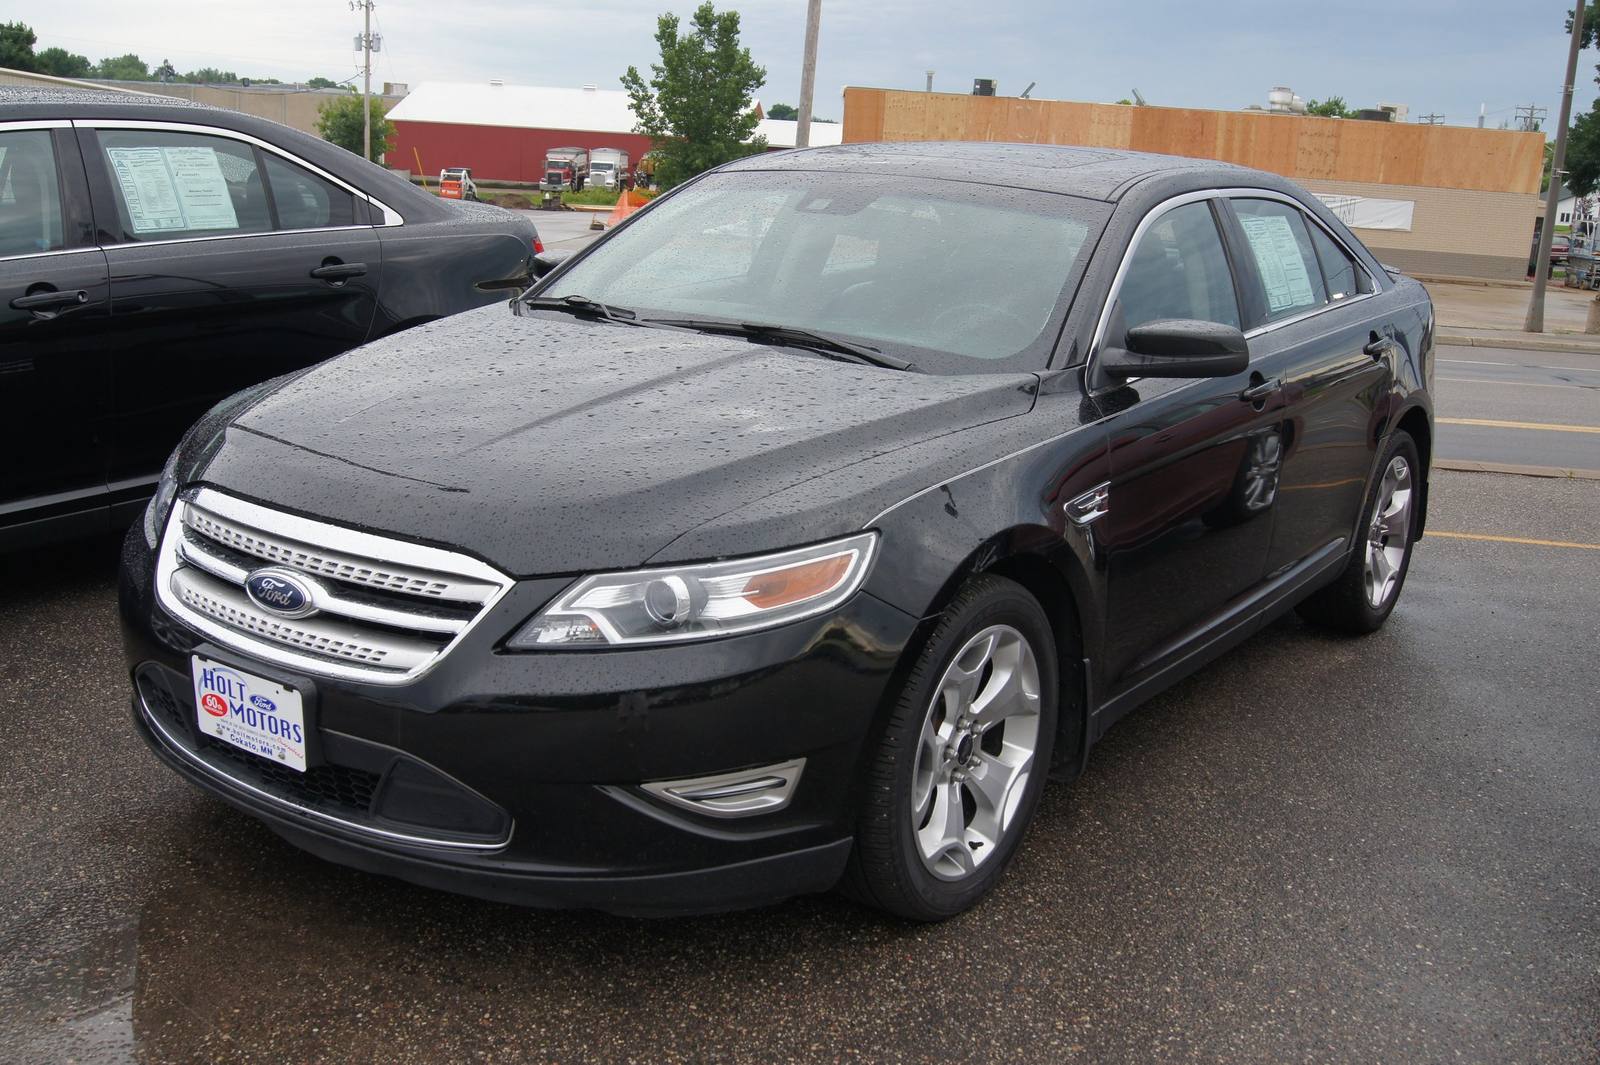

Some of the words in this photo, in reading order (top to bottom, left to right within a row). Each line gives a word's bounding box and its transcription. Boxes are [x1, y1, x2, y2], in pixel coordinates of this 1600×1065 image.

[257, 578, 293, 606] Ford
[202, 667, 246, 702] HOLT
[229, 700, 302, 744] MOTORS
[230, 733, 259, 753] Cokato,
[260, 746, 273, 756] MN
